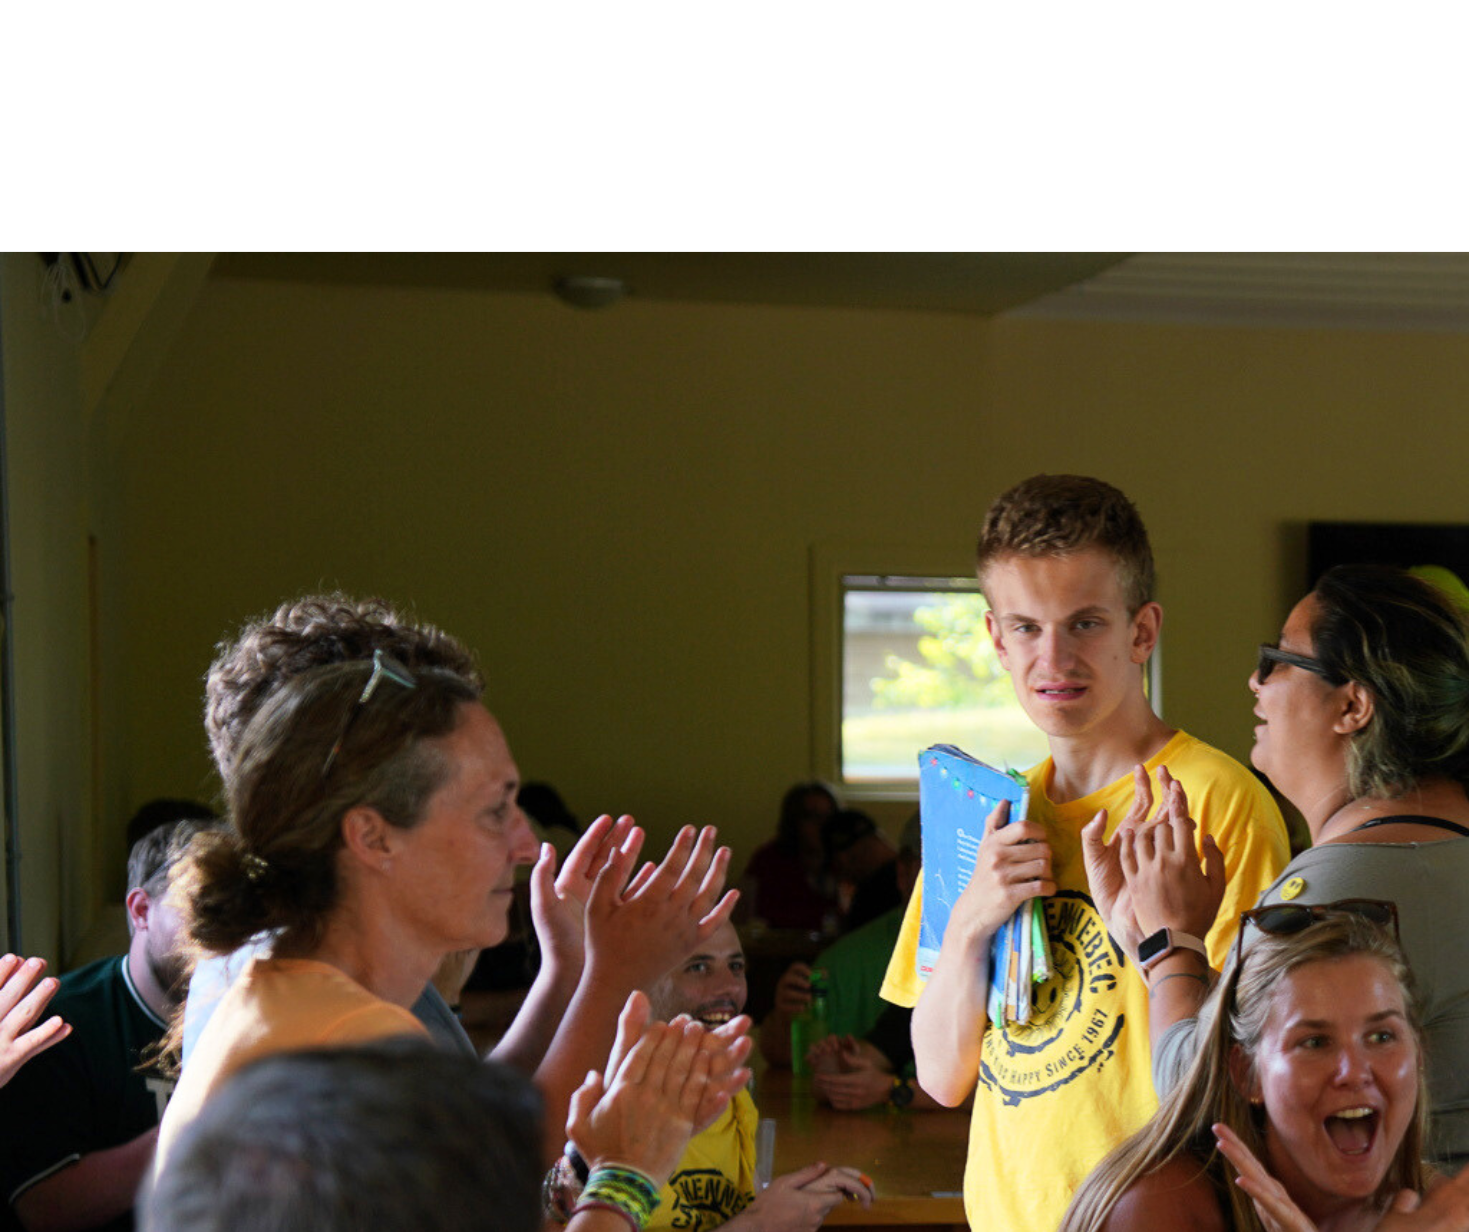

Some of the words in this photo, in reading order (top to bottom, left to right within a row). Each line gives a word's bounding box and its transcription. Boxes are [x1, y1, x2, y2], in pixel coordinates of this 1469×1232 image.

[1045, 901, 1117, 994] ENNEBEC
[1010, 1069, 1041, 1085] HAPPY
[1046, 1043, 1085, 1077] SINCE
[1079, 1008, 1108, 1044] 1967
[679, 1178, 747, 1214] KENNE
